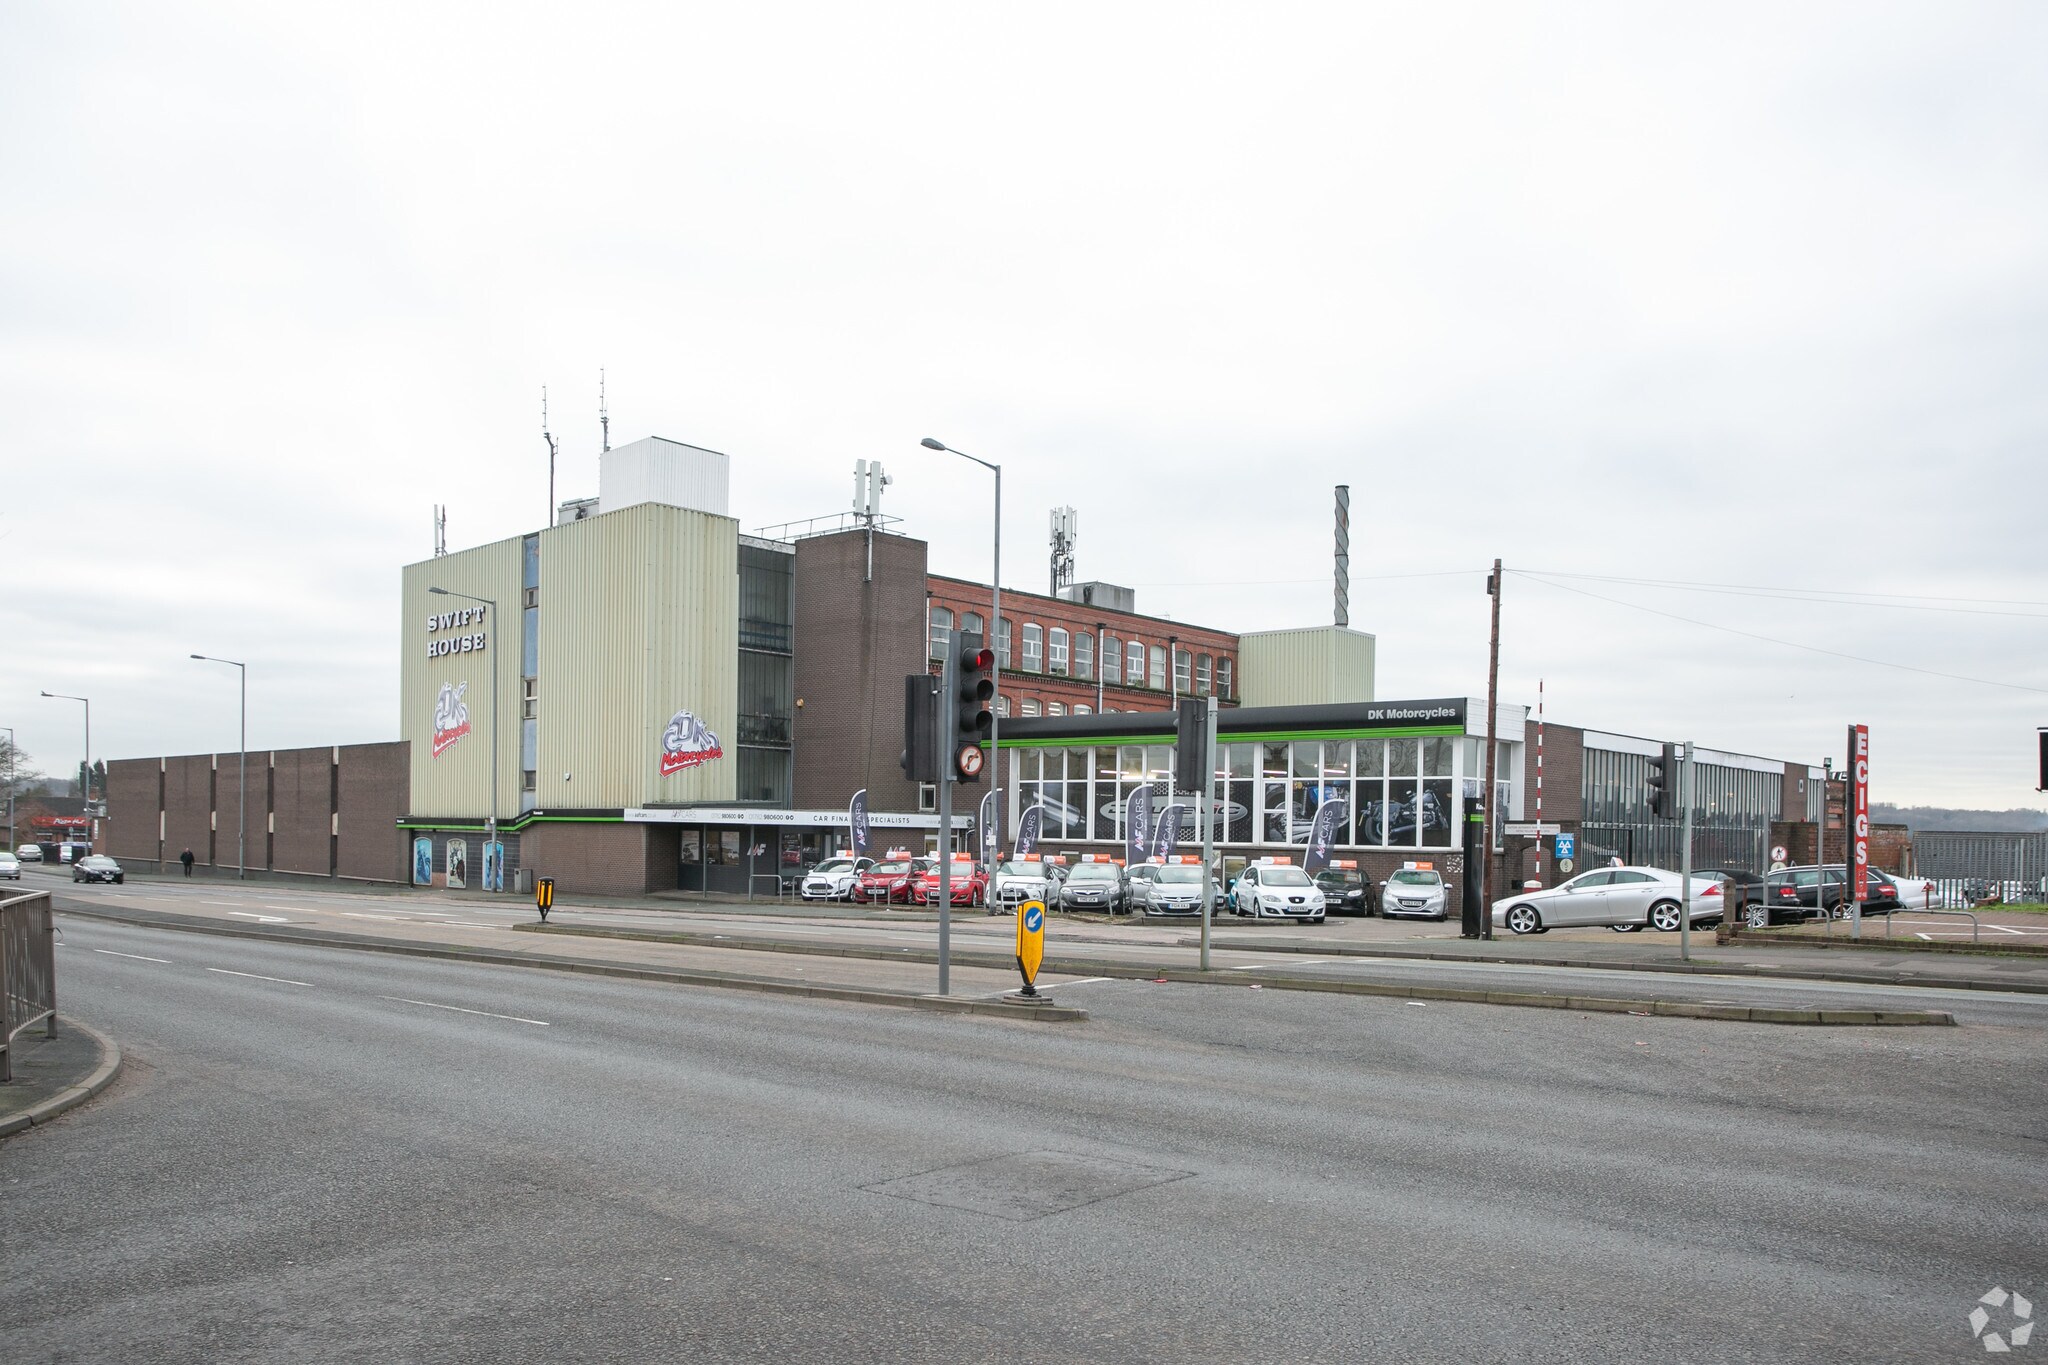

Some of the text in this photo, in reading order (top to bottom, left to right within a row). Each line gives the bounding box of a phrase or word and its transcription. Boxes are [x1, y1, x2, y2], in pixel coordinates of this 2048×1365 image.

[427, 605, 486, 632] SWIFT
[427, 632, 486, 658] HOUSE
[1367, 706, 1456, 720] DK Motorcycles
[660, 745, 724, 772] Motorcycles
[866, 816, 910, 824] SPECIALISTS
